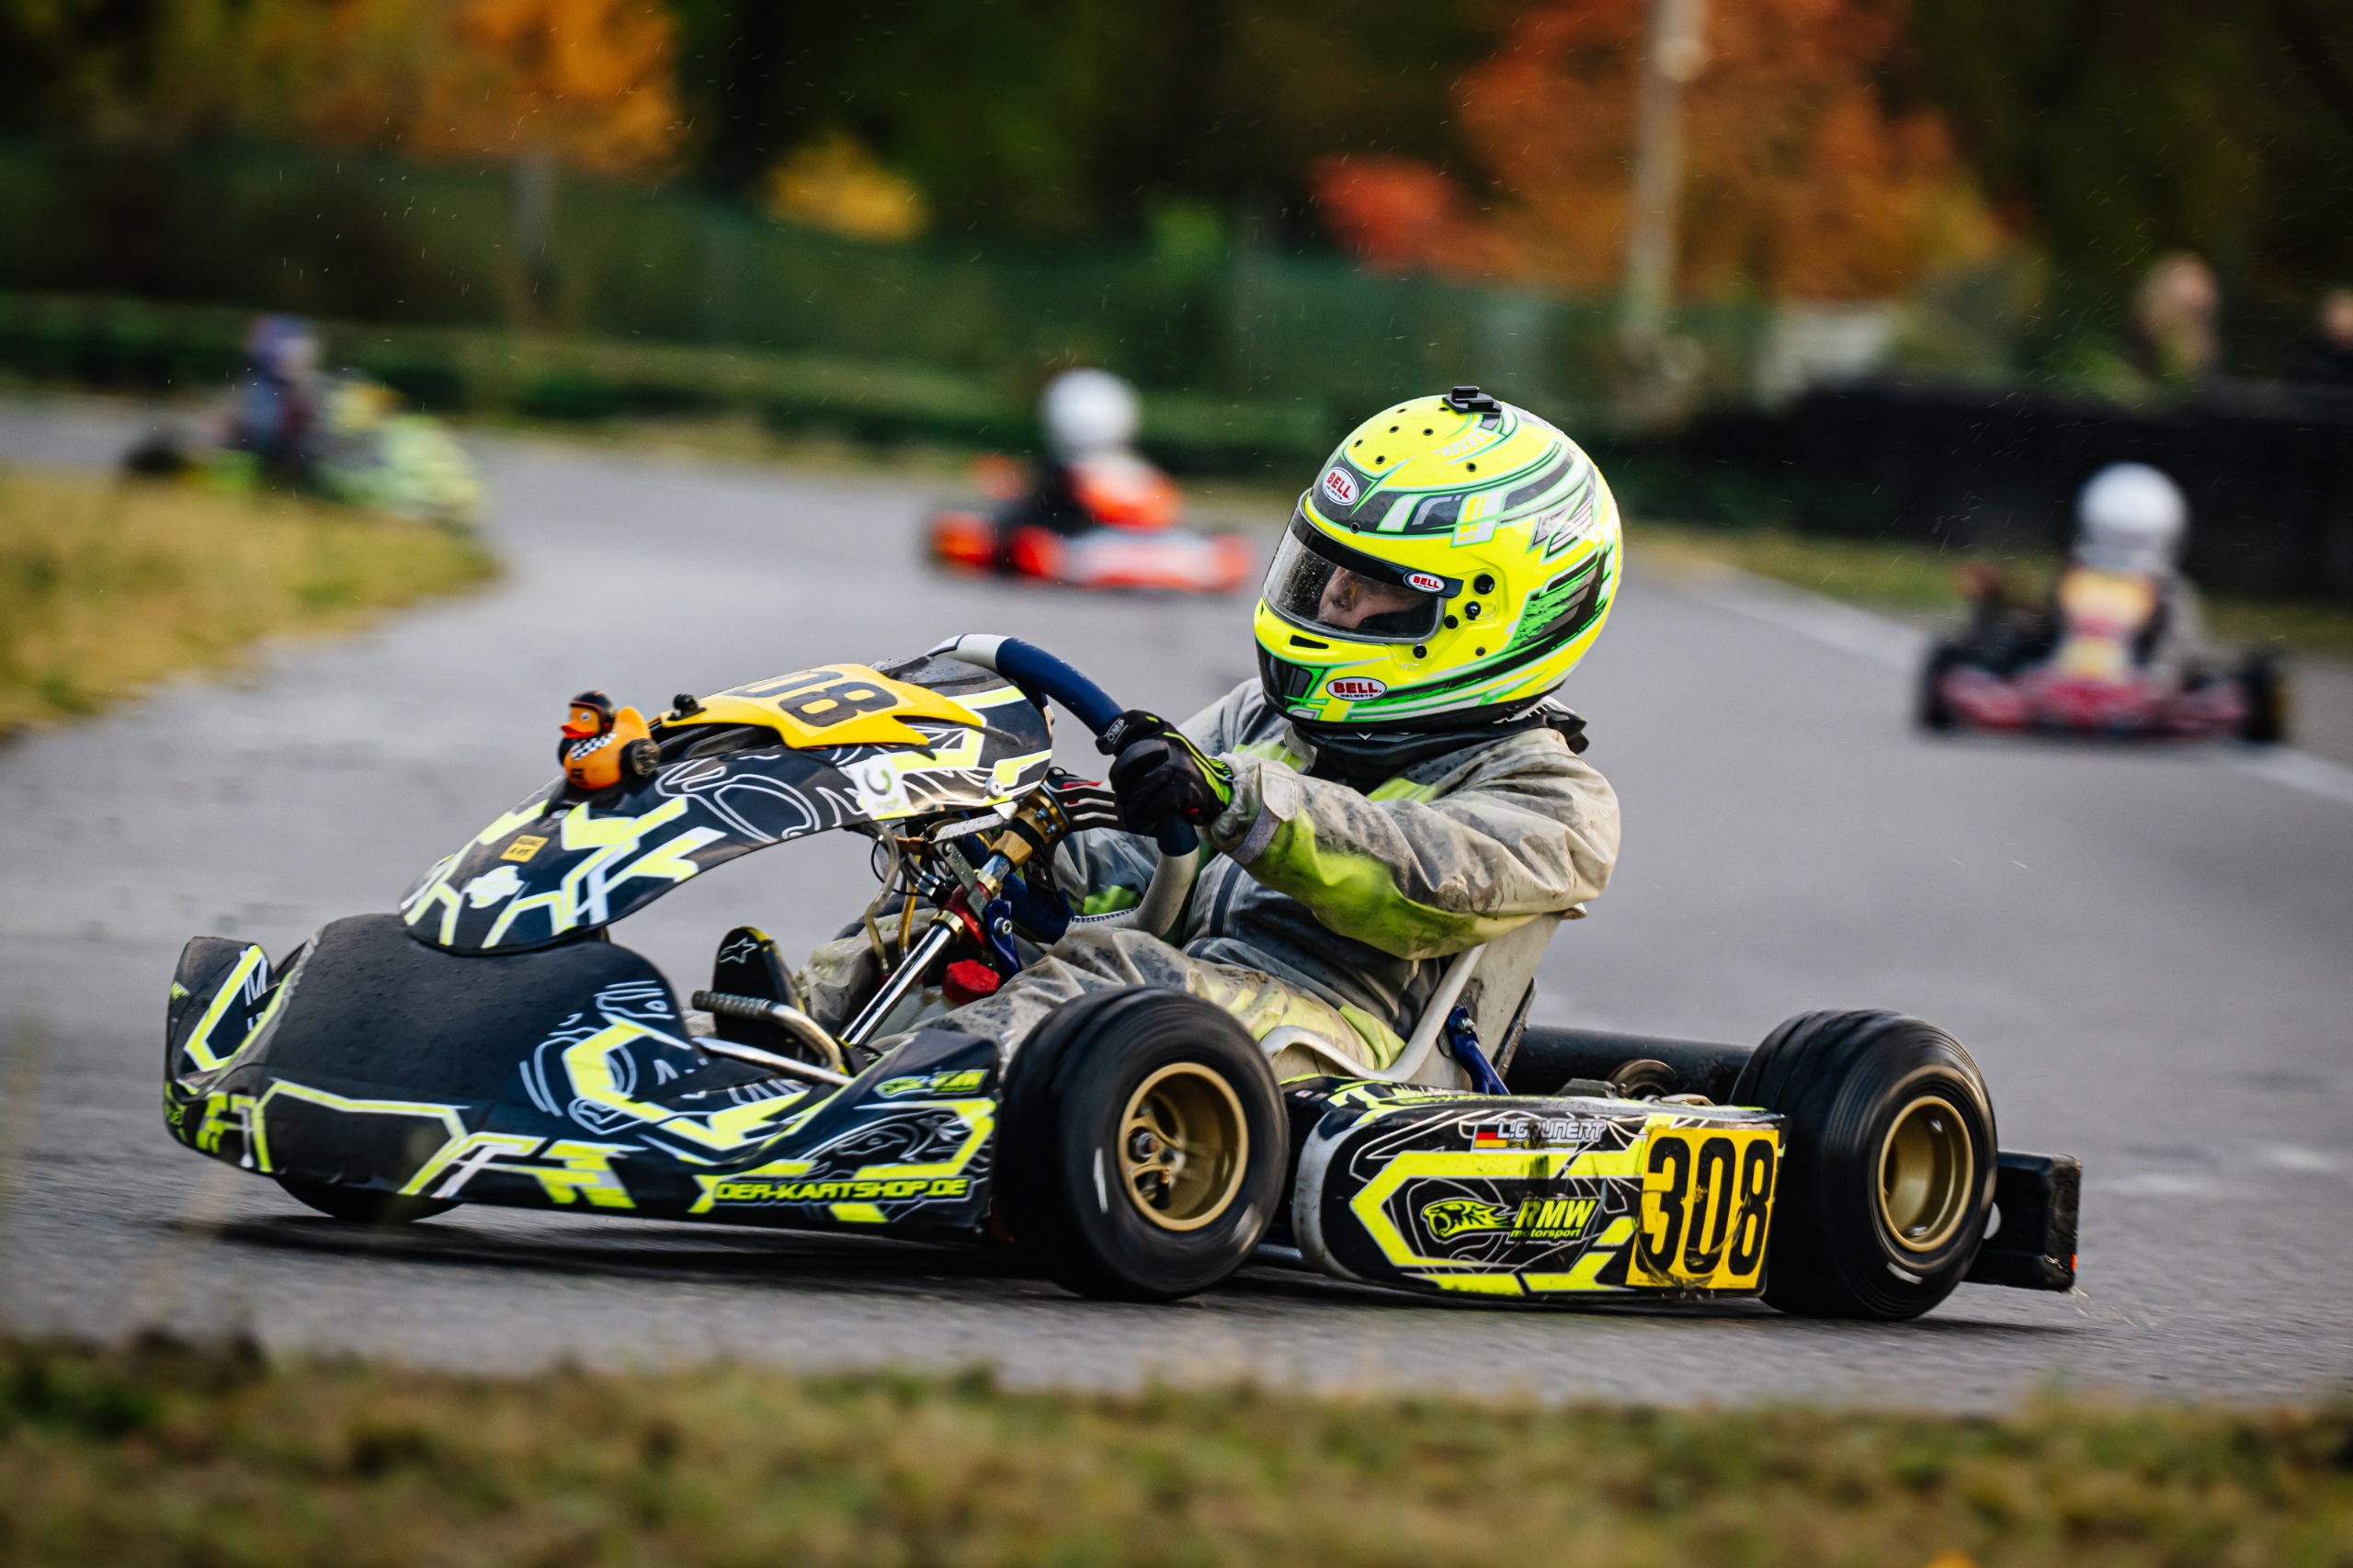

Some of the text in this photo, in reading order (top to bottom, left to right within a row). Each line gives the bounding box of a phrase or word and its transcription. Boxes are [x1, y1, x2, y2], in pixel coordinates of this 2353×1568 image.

[1326, 471, 1351, 499] BELL
[1413, 575, 1439, 588] BELL
[1333, 681, 1379, 694] BELL
[1107, 719, 1125, 742] OMP
[716, 1178, 969, 1199] DER-KARTSHOP.DE
[1514, 1199, 1597, 1228] RMW
[1635, 1136, 1775, 1276] 308
